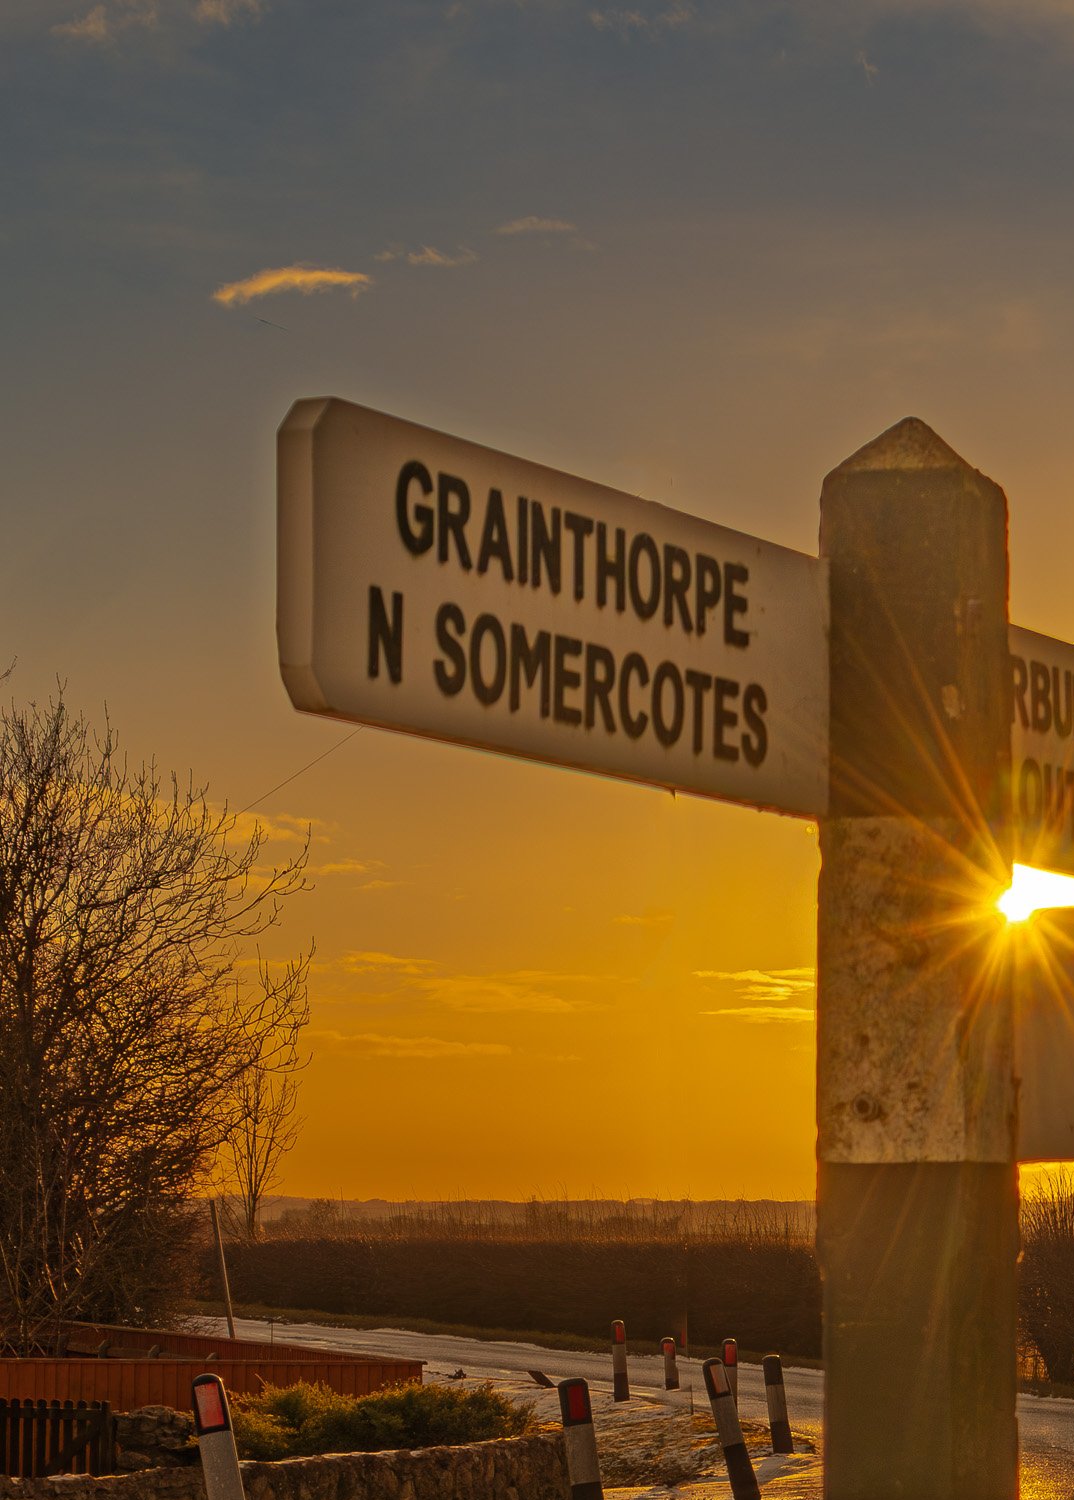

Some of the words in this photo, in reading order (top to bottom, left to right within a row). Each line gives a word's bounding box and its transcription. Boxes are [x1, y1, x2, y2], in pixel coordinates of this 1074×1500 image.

[396, 460, 749, 649] GRAINTHORPE
[368, 585, 403, 684] N
[433, 603, 768, 768] SOMERCOTES
